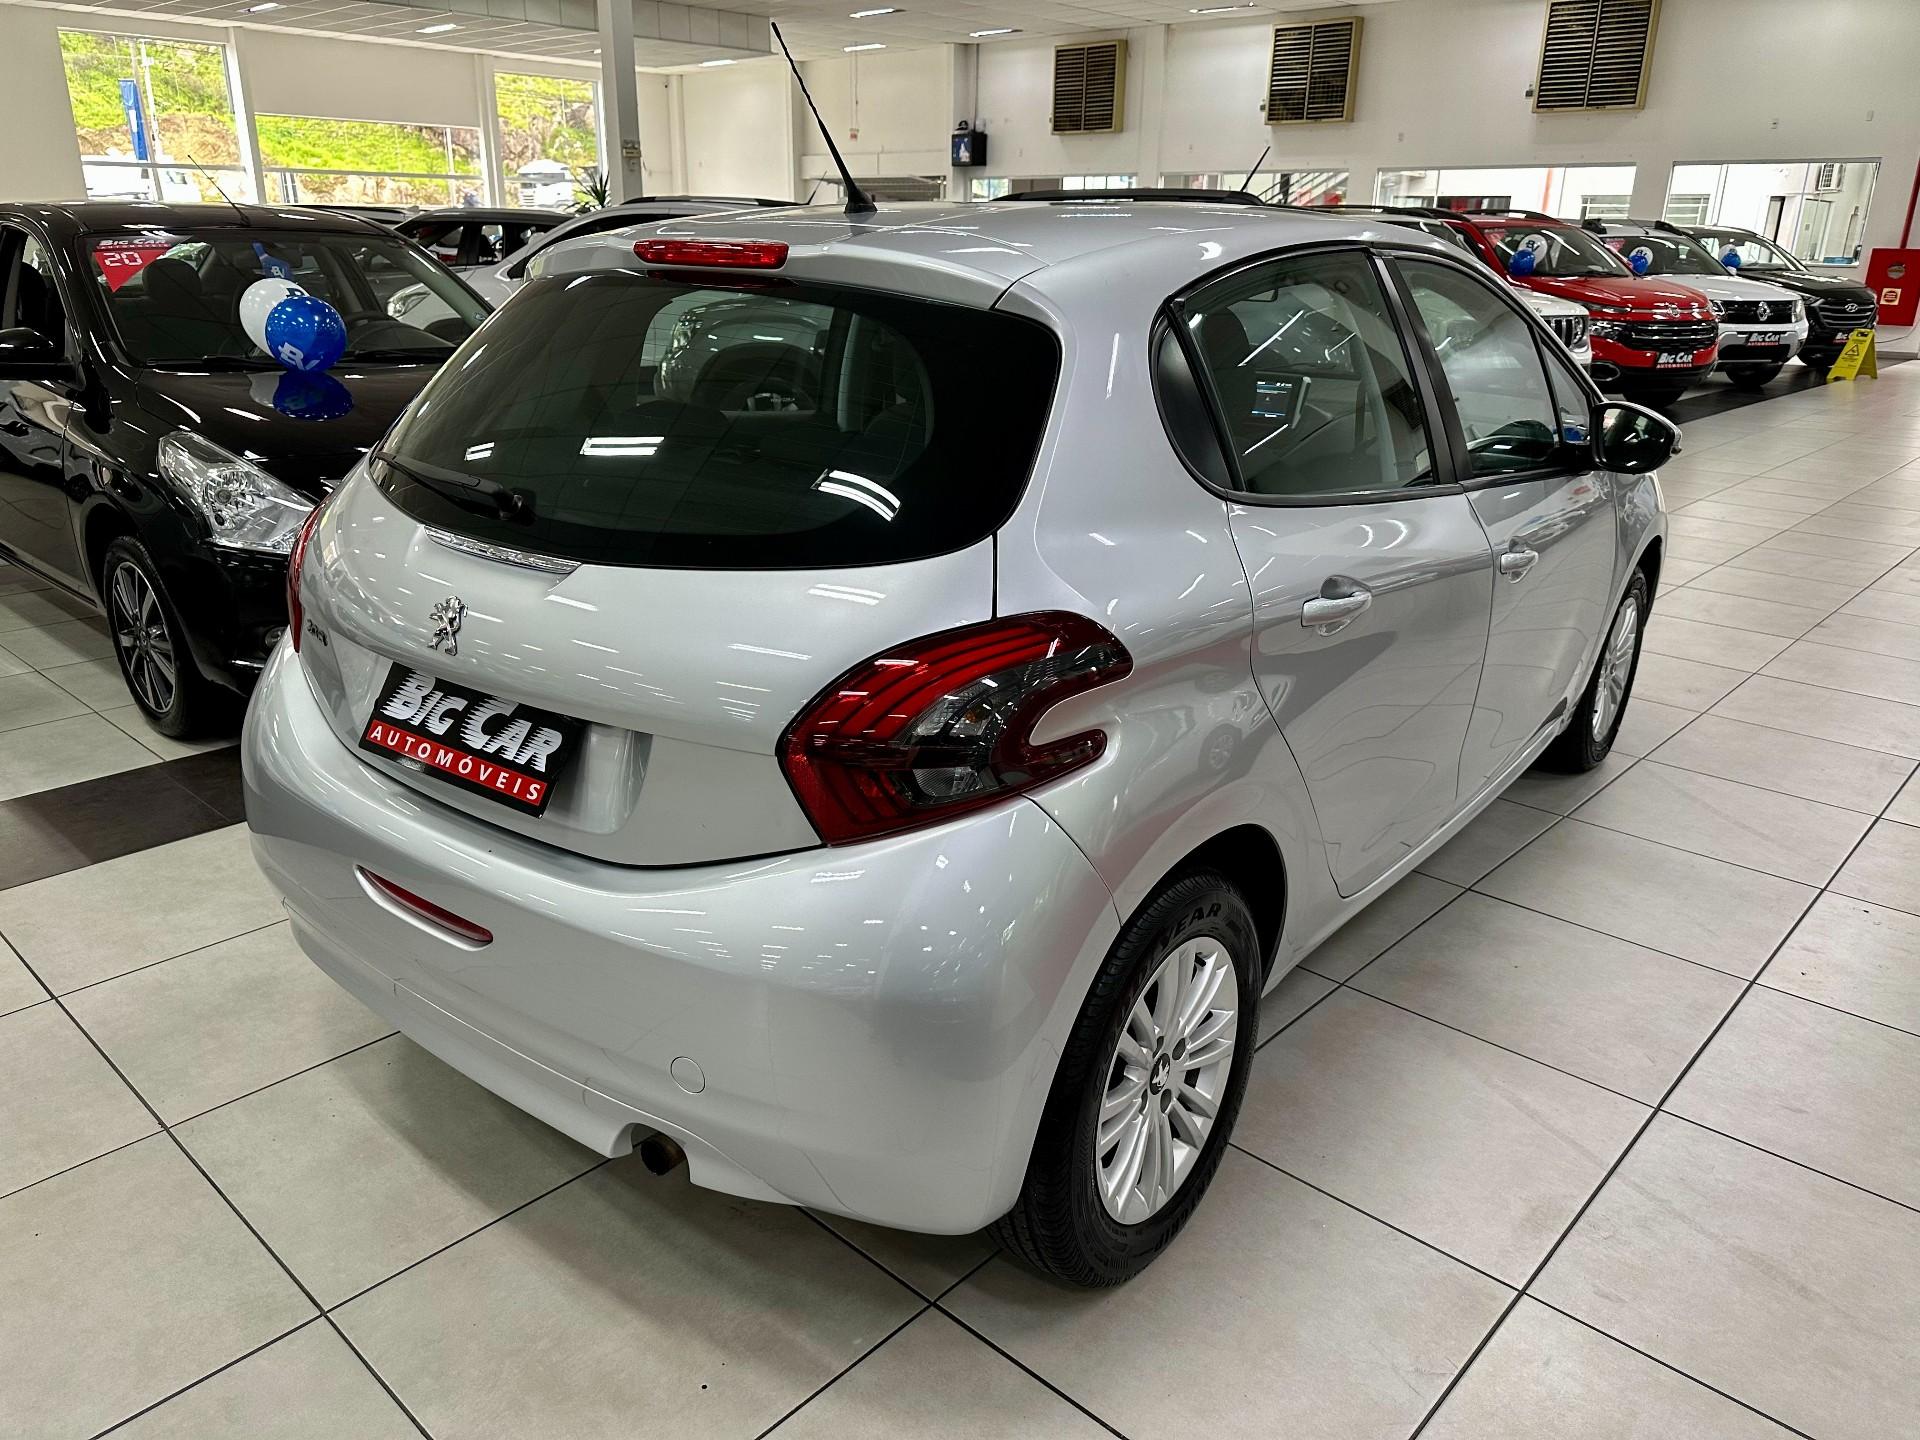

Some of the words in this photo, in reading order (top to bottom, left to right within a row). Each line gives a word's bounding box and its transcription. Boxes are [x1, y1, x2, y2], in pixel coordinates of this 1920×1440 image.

[1657, 352, 1676, 364] BIG
[1675, 352, 1693, 363] CAR
[380, 669, 469, 736] BIG
[459, 697, 563, 773] CAR
[370, 725, 542, 801] AUTOMÓVEIS
